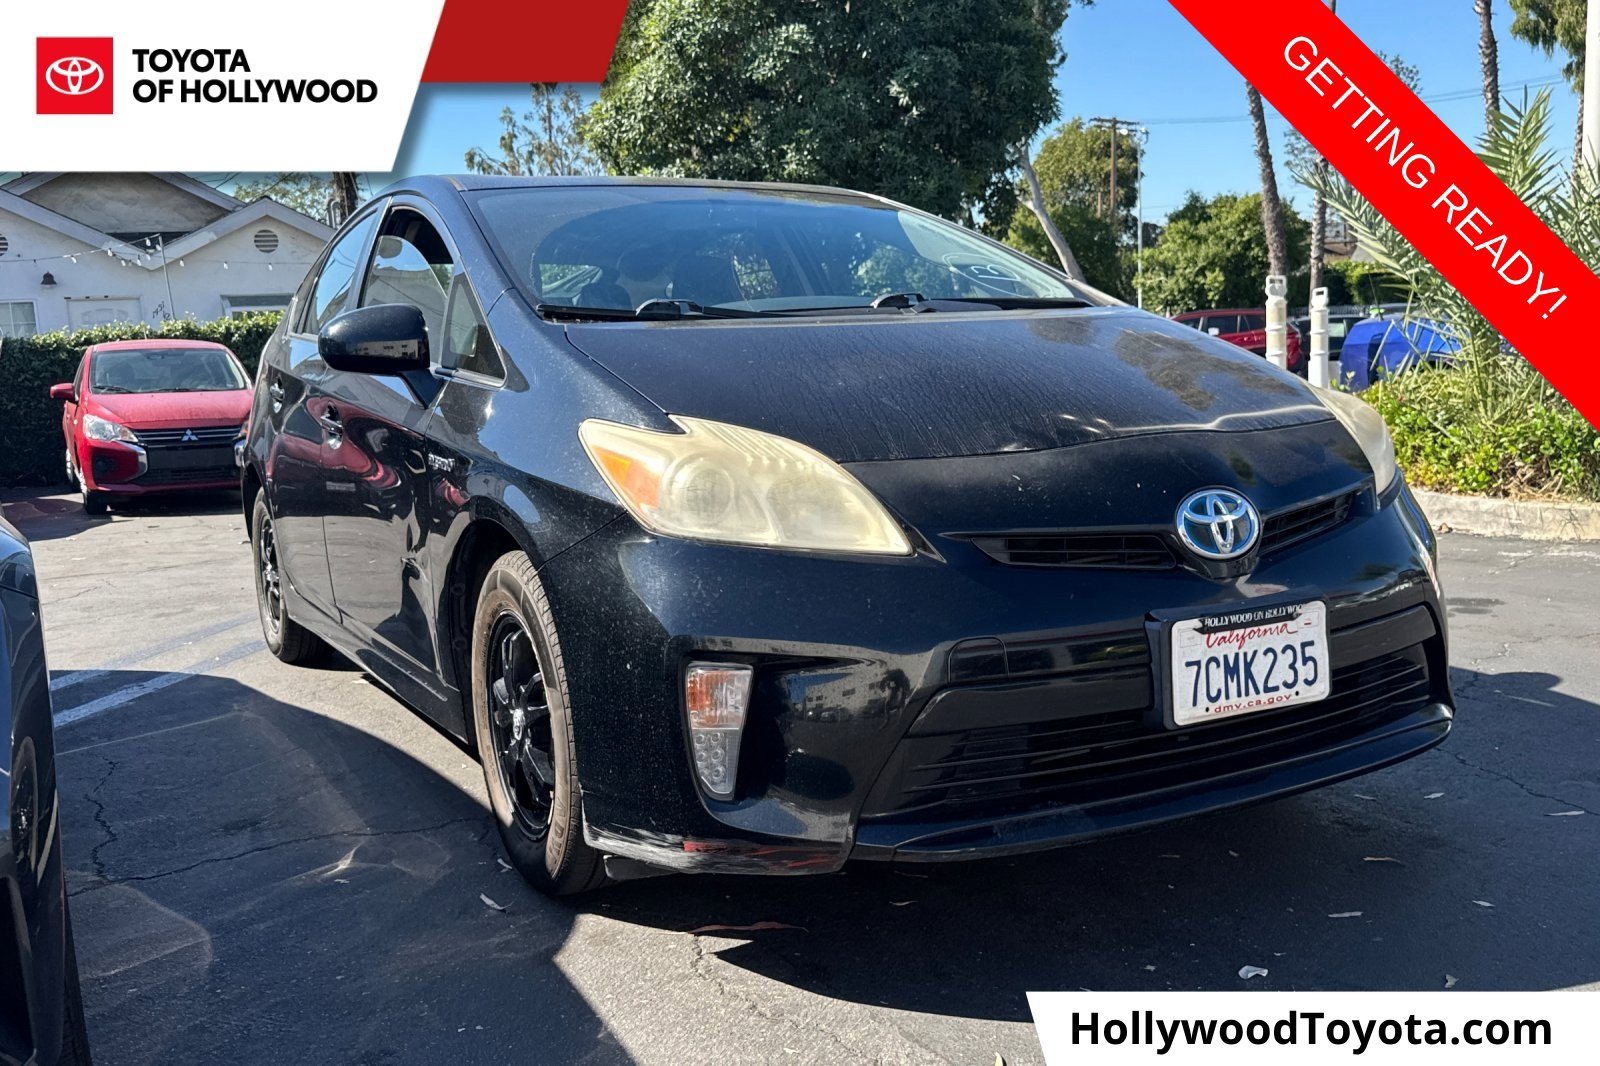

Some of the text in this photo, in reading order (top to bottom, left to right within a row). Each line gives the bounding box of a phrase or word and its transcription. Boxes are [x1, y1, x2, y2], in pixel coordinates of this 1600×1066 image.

[1206, 622, 1298, 650] California
[1184, 640, 1318, 707] 7CMK235
[1214, 694, 1292, 714] dmv.ca.gov
